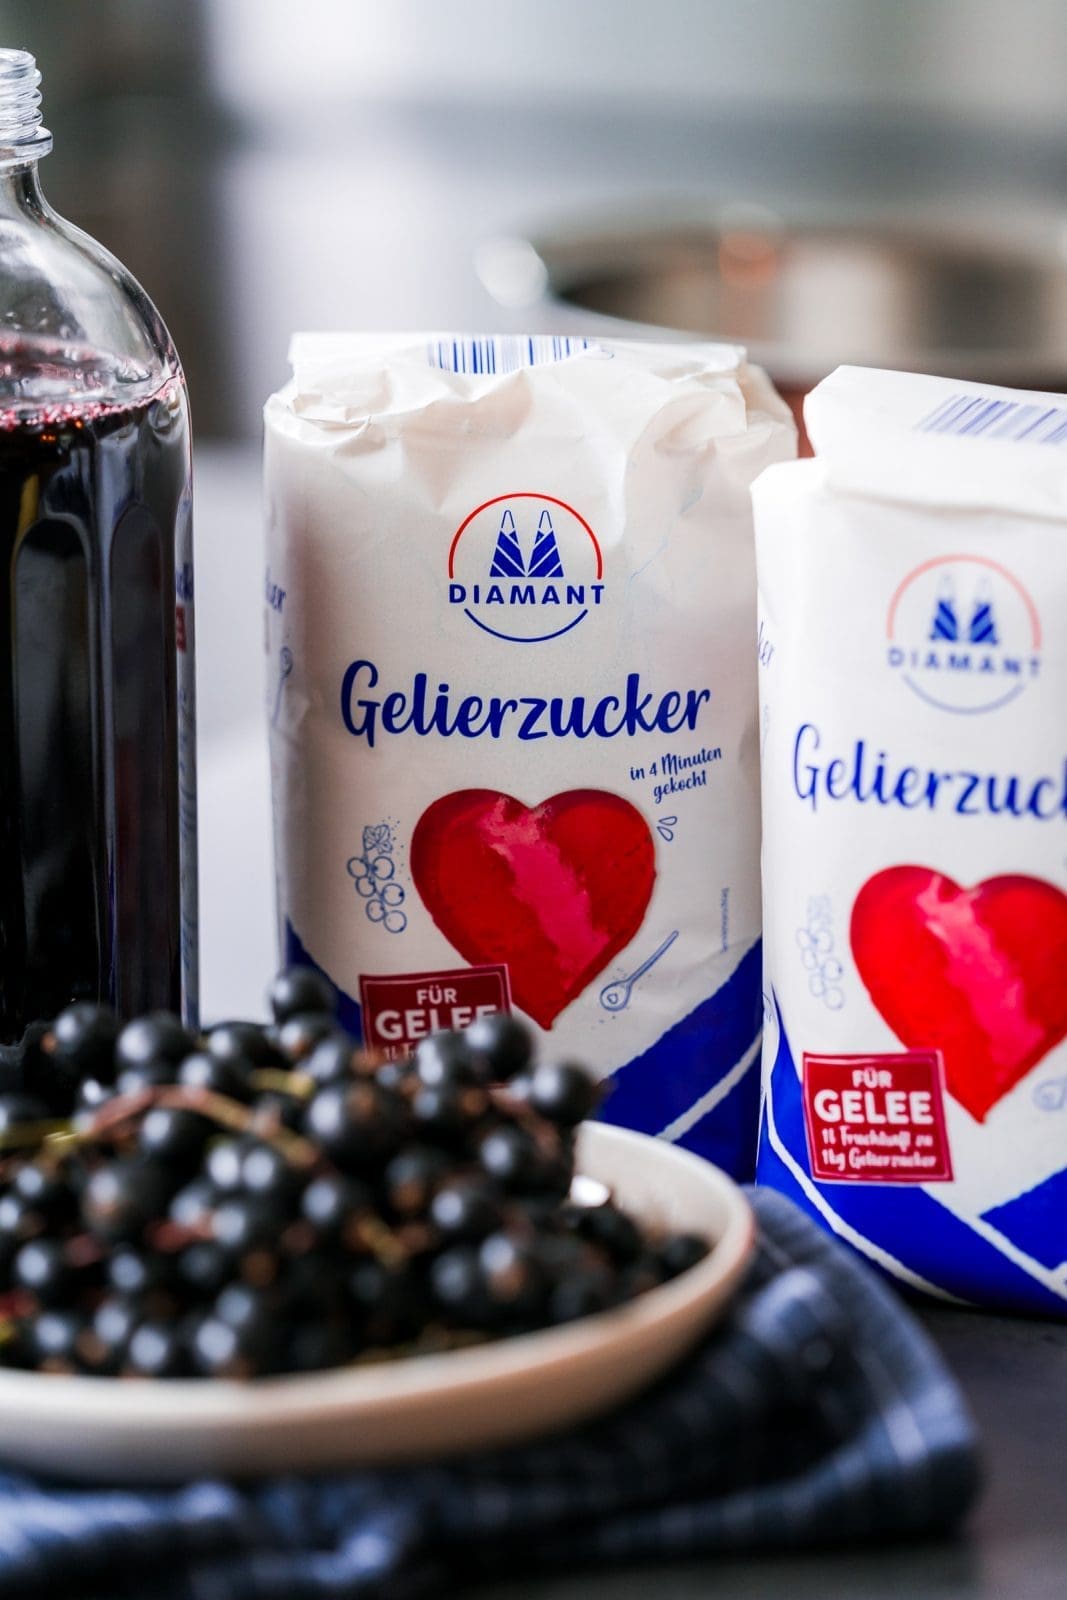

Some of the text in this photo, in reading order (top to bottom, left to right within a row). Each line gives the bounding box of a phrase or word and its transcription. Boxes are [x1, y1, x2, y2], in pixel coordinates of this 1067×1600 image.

[449, 584, 605, 605] DIAMANT
[887, 646, 1040, 678] DIAMANT
[341, 660, 711, 748] Gelierzucker
[630, 747, 722, 781] in 4 Minuten
[653, 769, 707, 804] gekocht
[416, 985, 457, 1005] FÜR
[852, 1066, 892, 1088] FÜR
[813, 1089, 934, 1125] GELEE
